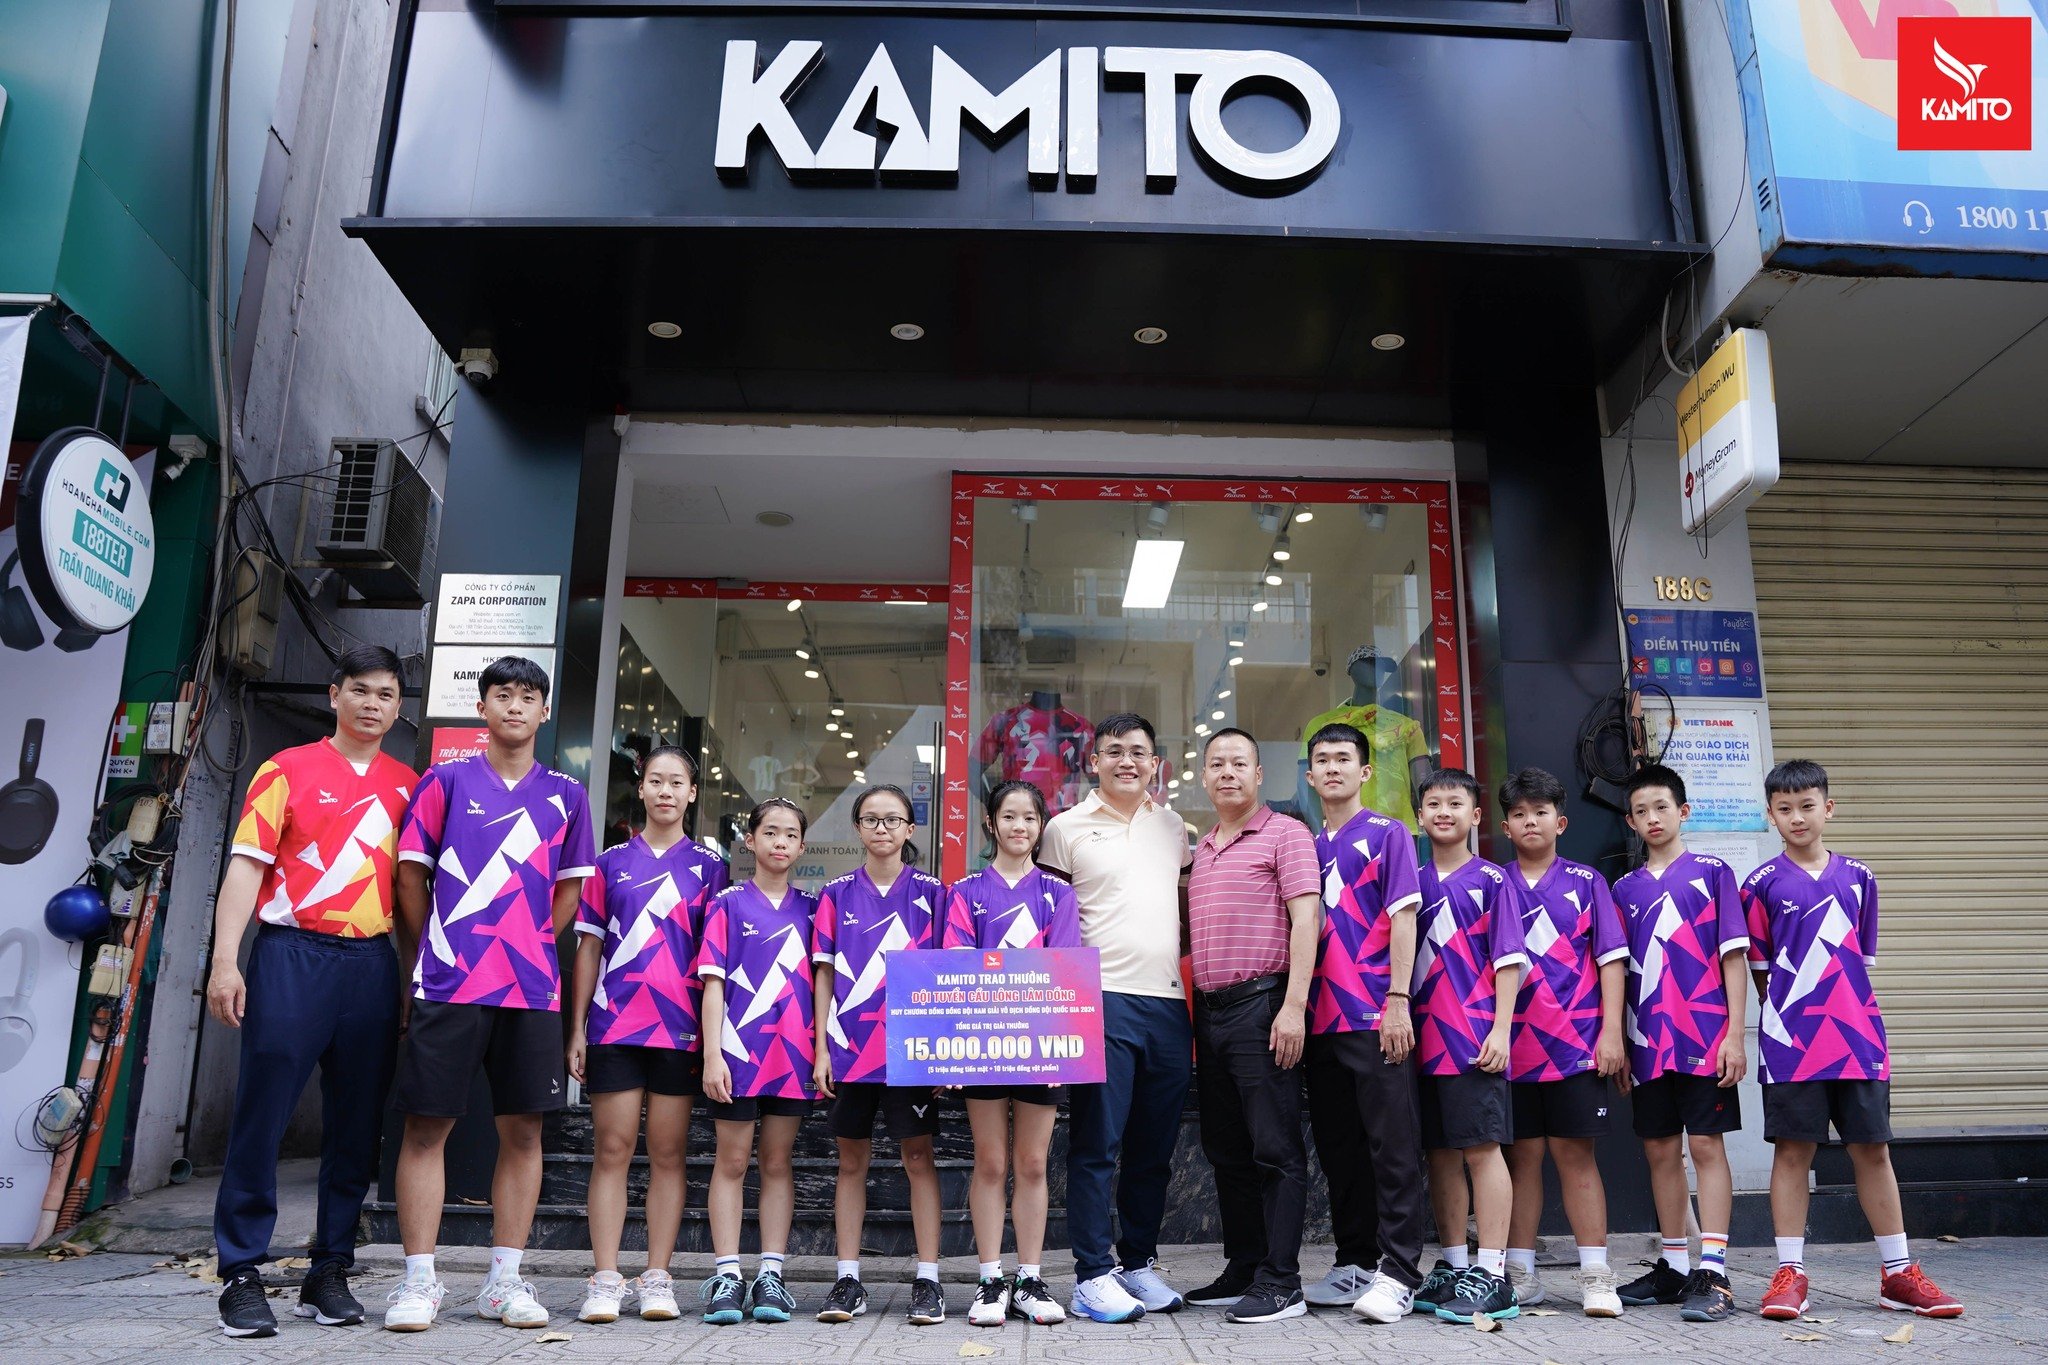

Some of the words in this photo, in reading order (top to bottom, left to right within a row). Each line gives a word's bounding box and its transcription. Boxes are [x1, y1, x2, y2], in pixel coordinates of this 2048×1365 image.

[714, 39, 1341, 186] KAMITO
[1956, 205, 2018, 230] 1800
[1695, 439, 1737, 483] MoneyGram
[62, 478, 150, 550] HOANGHAMOBILE.COM
[81, 518, 128, 571] 188TER
[59, 547, 84, 580] TRẦN
[84, 565, 114, 598] QUANG
[115, 583, 136, 612] KHẢI
[1653, 575, 1714, 602] 188C
[450, 596, 476, 606] ZAPA
[479, 596, 547, 606] CORPORATION
[1644, 636, 1679, 651] ĐIỂM
[1681, 640, 1709, 652] THU
[1711, 638, 1741, 653] TIỀN
[1683, 719, 1734, 727] VIETBANK
[438, 746, 458, 758] TRÊN
[1695, 740, 1722, 749] GIAO
[1724, 741, 1750, 752] DỊCH
[1685, 752, 1723, 762] QUANG
[1726, 750, 1750, 762] KHẢI
[547, 769, 580, 785] KAMITO
[1367, 816, 1391, 827] KAMITO
[692, 845, 721, 862] KAMITO
[804, 846, 830, 855] HANH
[832, 846, 859, 855] TOÁN
[1694, 856, 1723, 868] KAMITO
[1845, 859, 1873, 880] KAMITO
[795, 865, 825, 877] VISA
[912, 872, 942, 886] KAMITO
[1480, 865, 1504, 884] KAMITO
[1565, 865, 1594, 880] KAMITO
[1749, 864, 1776, 886] KAMITO
[936, 973, 976, 986] KAMITO
[978, 973, 1006, 985] TRAO
[1008, 970, 1051, 984] THƯỞNG
[911, 988, 932, 1006] ĐỘI
[933, 986, 966, 1003] TUYỂN
[968, 987, 990, 1003] CẦU
[991, 987, 1020, 1003] LÔNG
[1021, 986, 1044, 1002] LÂM
[1045, 985, 1076, 1002] ĐỒNG
[890, 1008, 902, 1016] HUY
[971, 1021, 982, 1030] GIÁ
[982, 1022, 992, 1031] TRỊ
[904, 1035, 1032, 1061] 15.000.000
[1038, 1034, 1085, 1060] VND
[994, 1064, 1001, 1072] 10
